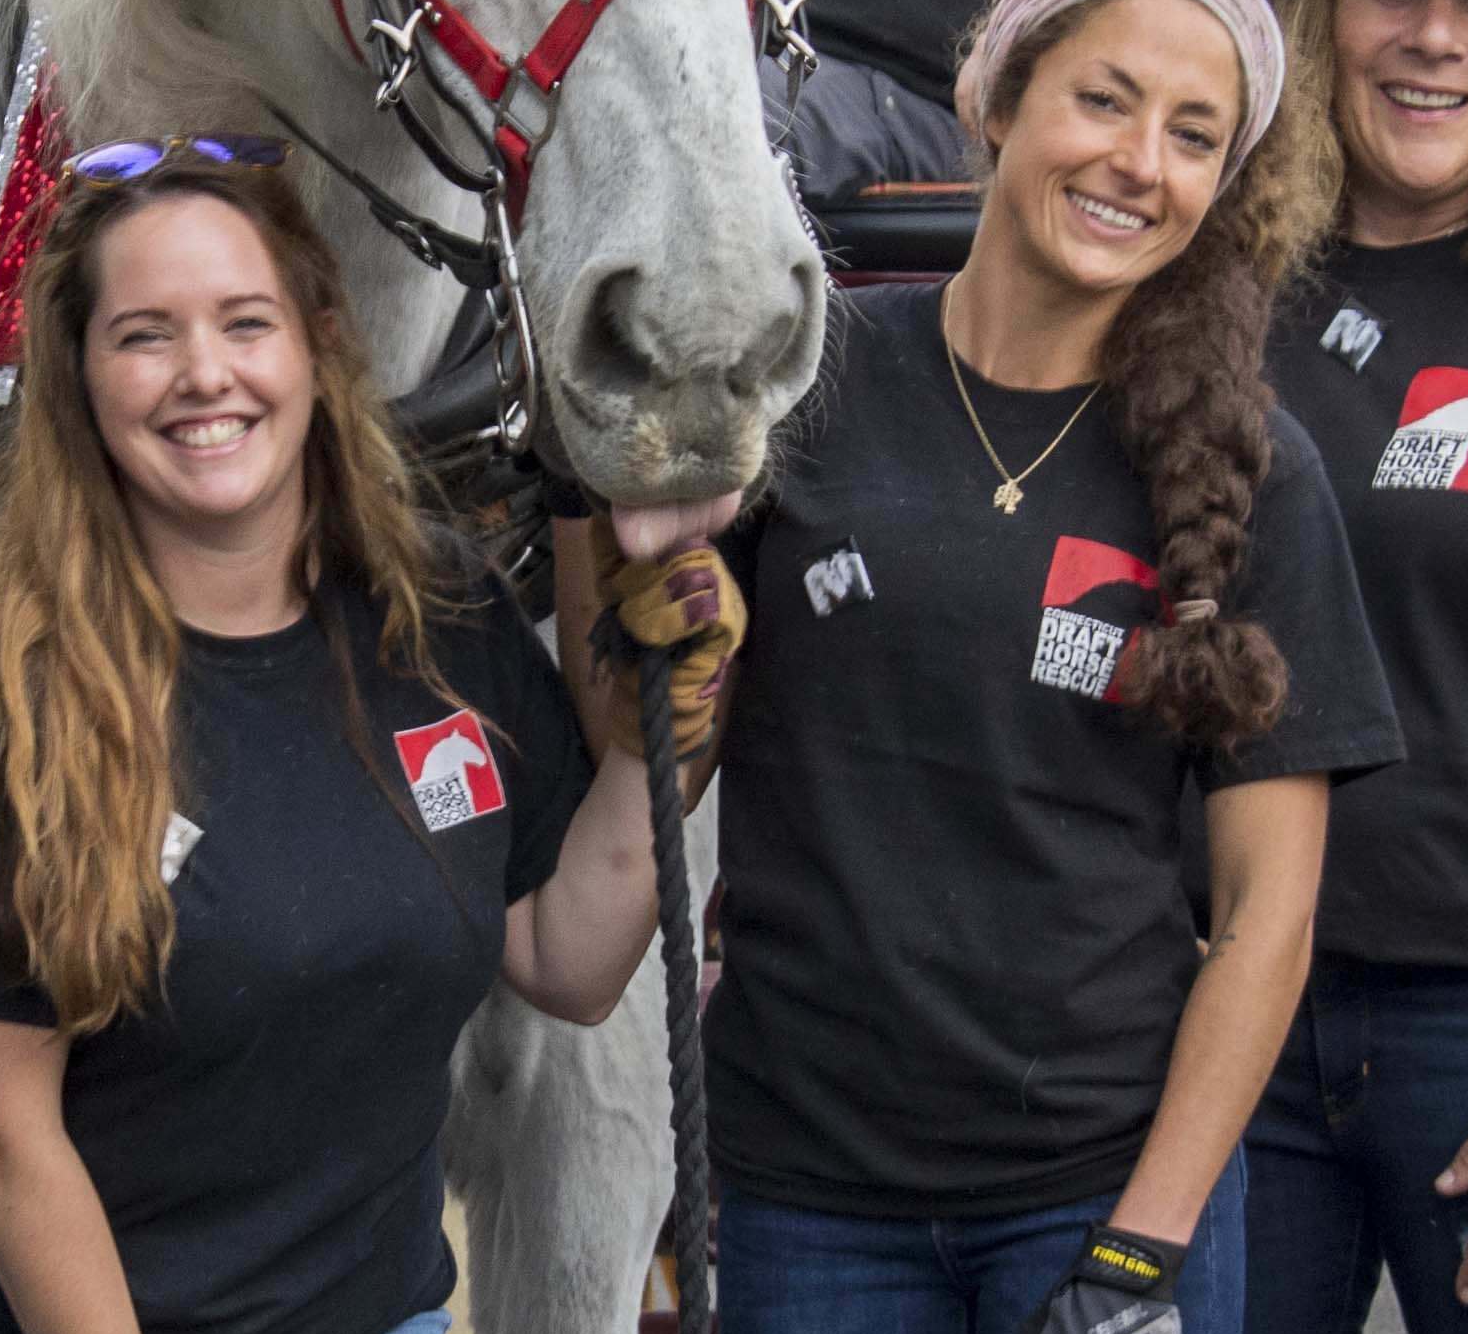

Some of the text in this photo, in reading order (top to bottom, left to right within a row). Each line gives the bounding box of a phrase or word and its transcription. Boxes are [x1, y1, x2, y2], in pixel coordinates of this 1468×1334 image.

[1388, 435, 1467, 454] DRAFT
[1380, 451, 1459, 470] HORSE
[1375, 467, 1452, 486] RESCUE
[1043, 607, 1125, 638] CONNECTICUT
[1039, 618, 1123, 661] DRAFT
[1035, 640, 1116, 679] HORSE
[1031, 658, 1109, 701] RESCUE
[417, 777, 462, 805] DRAFT
